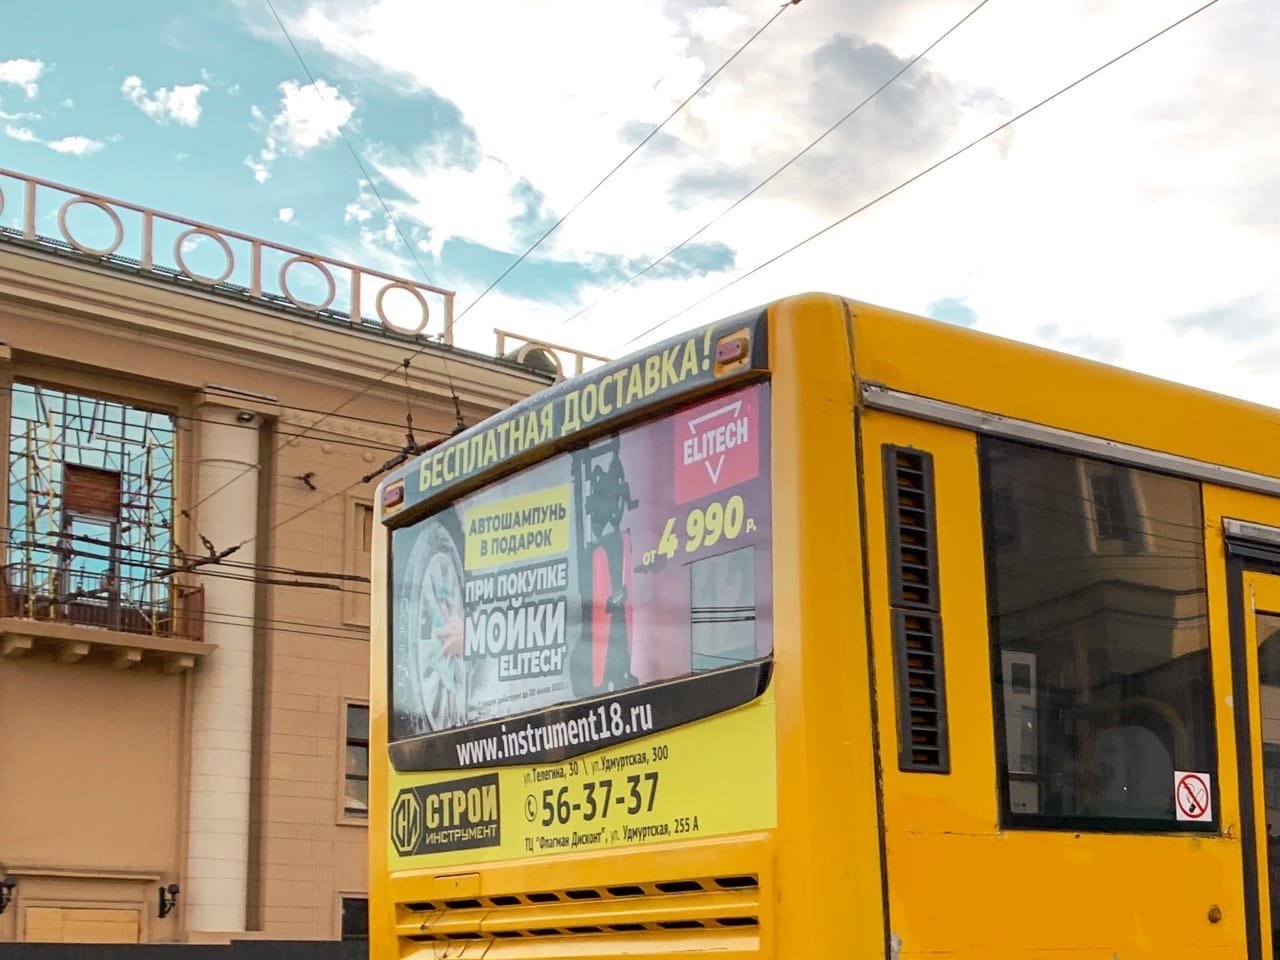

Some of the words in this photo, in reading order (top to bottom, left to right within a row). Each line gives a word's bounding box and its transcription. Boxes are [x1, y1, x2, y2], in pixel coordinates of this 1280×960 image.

[419, 404, 554, 492] БЕСПЛАТНАЯ
[561, 325, 715, 436] ДОСТАВКА!
[683, 417, 748, 465] ELITECH
[469, 503, 566, 536] АВТОШАМПУНЬ
[685, 495, 744, 552] 990
[480, 541, 487, 556] В
[491, 529, 552, 555] ПОДАРОК
[465, 578, 494, 603] ПРИ
[498, 563, 567, 598] ПОКУПКЕ
[465, 597, 566, 656] МОЙКИ
[456, 702, 653, 766] www.instrument18.ru
[568, 762, 578, 776] 30
[652, 745, 669, 761] 300
[542, 772, 659, 827] 56-37-37
[426, 824, 497, 846] ИНСТРУМЕНТ
[674, 818, 690, 834] 255
